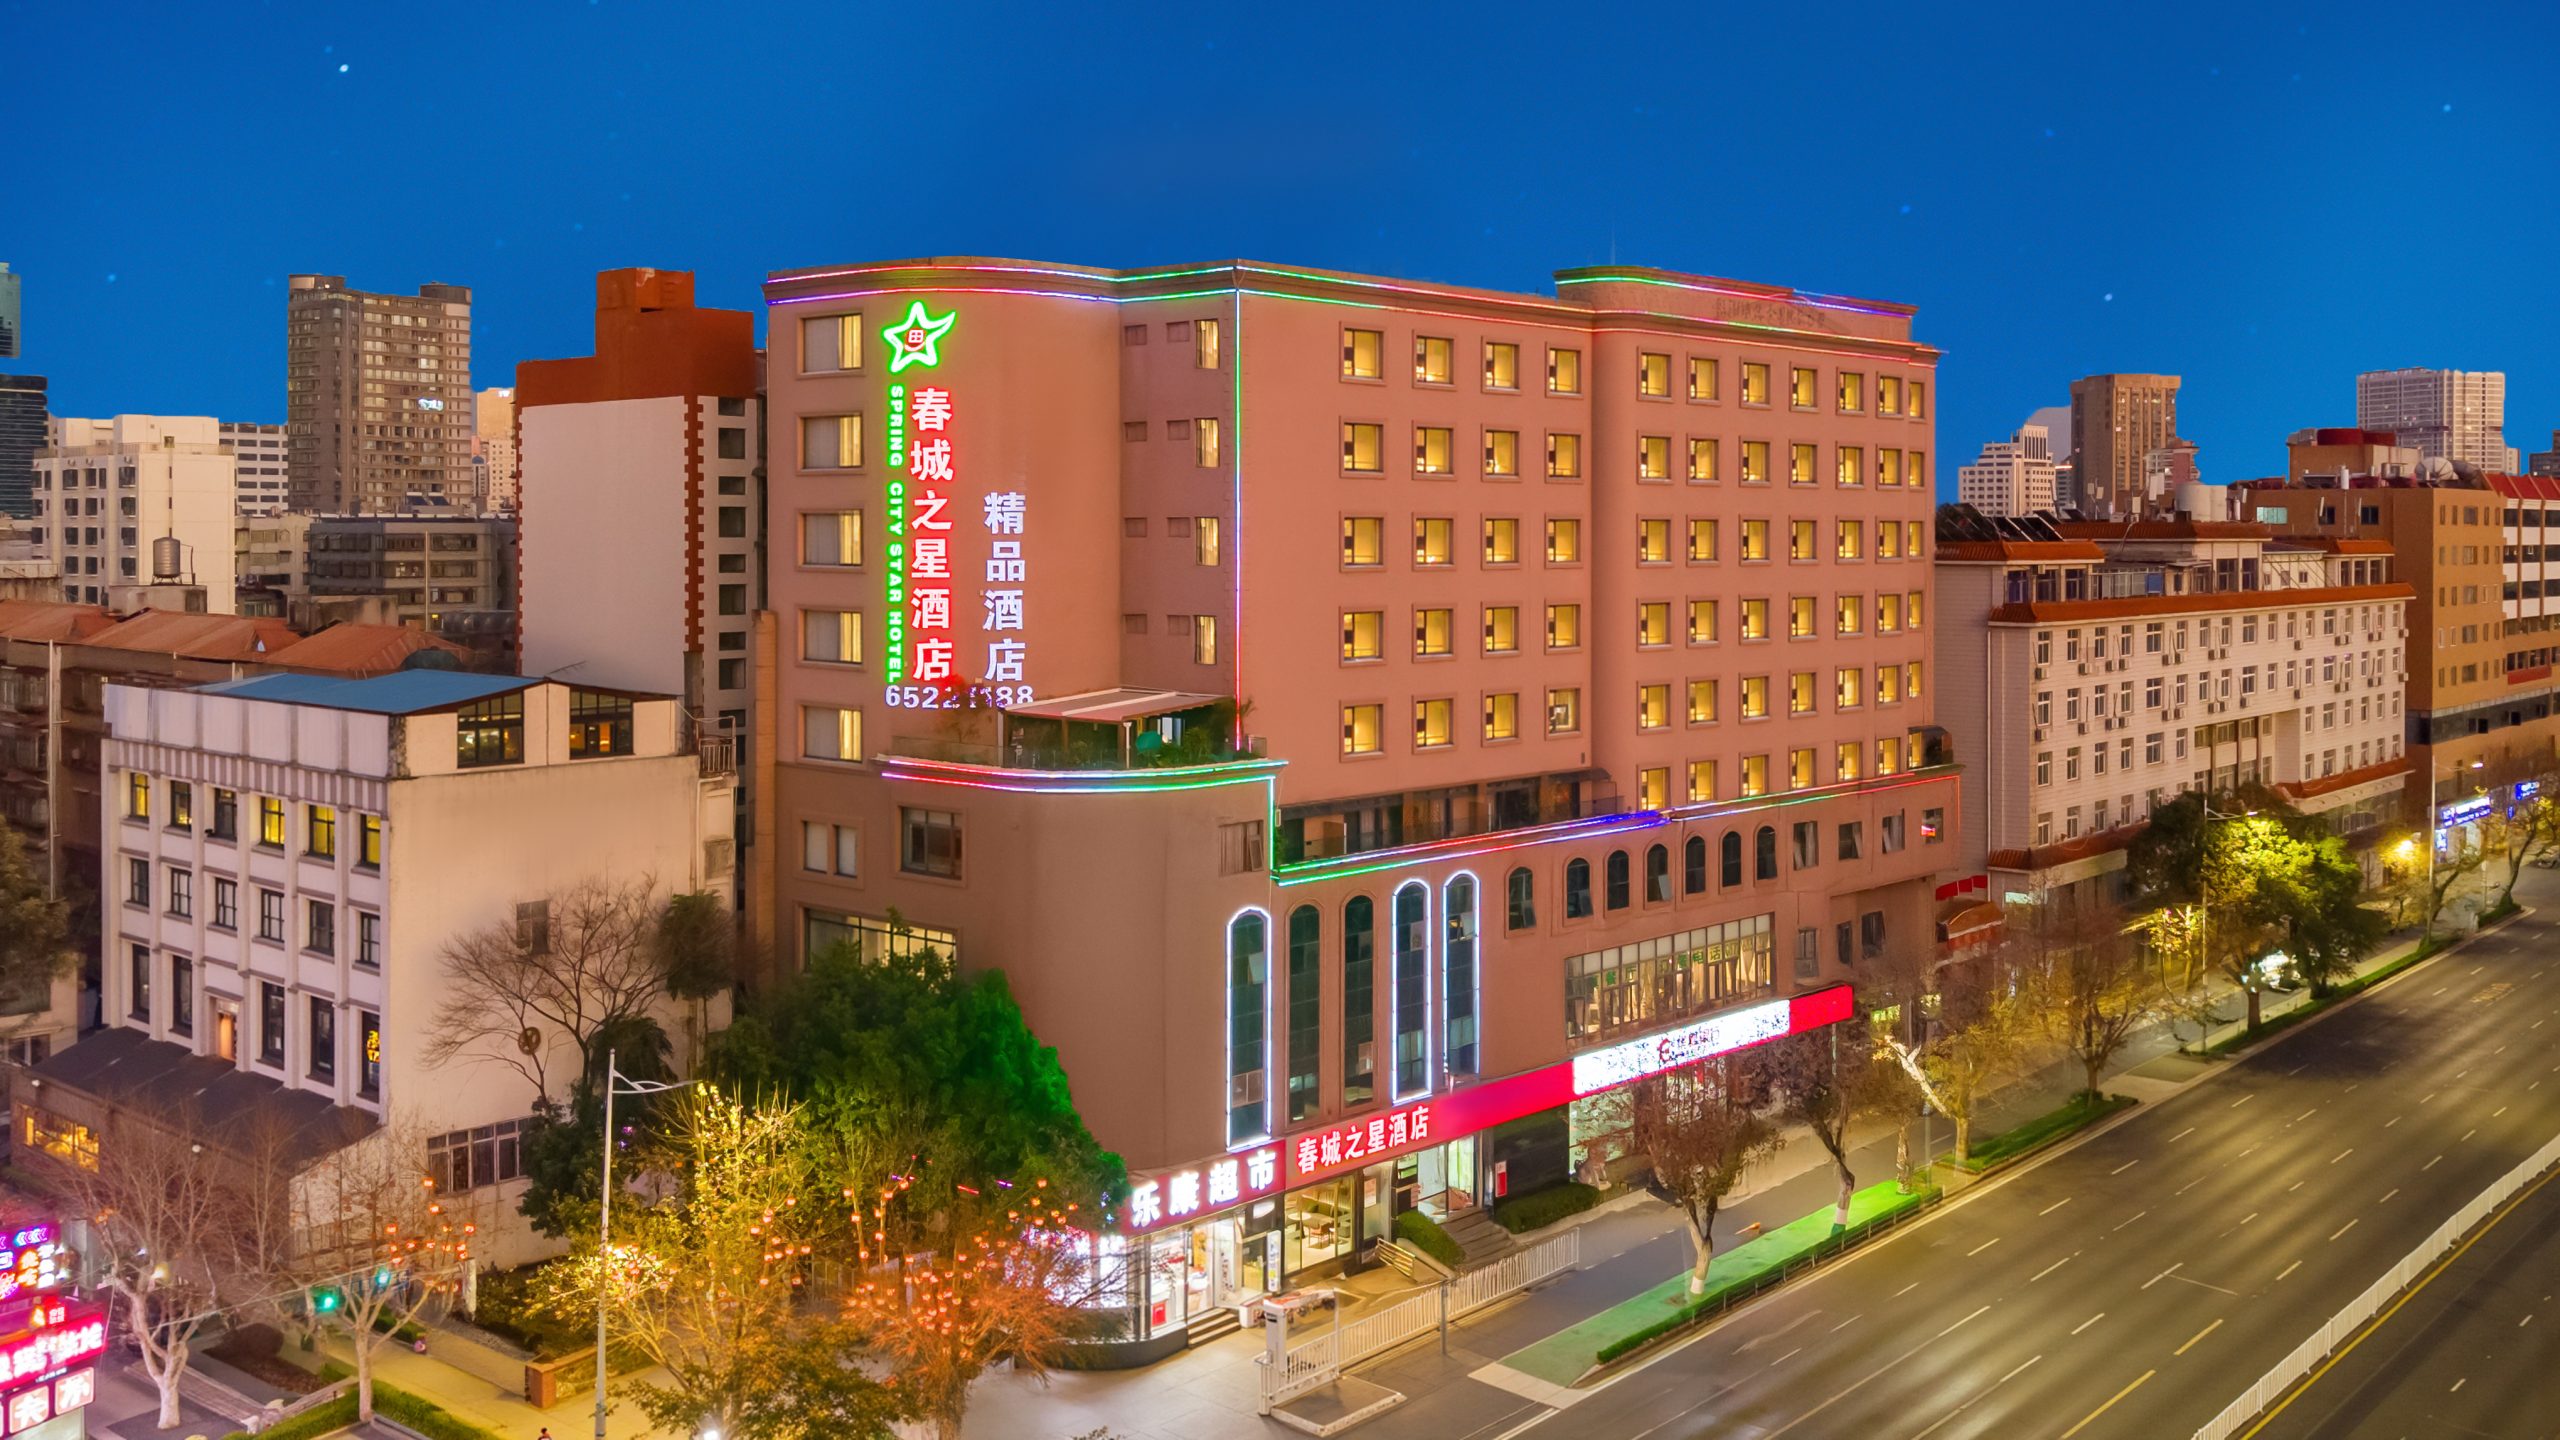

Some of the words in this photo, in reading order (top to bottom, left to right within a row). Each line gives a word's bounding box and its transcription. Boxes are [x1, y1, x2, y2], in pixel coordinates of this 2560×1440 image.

[891, 385, 904, 466] SPRING
[889, 482, 904, 535] CITY
[911, 388, 954, 681] 春城之星酒店
[889, 543, 903, 602] STAR
[983, 491, 1026, 682] 精品酒店
[889, 611, 903, 682] HOTEL
[1298, 1105, 1429, 1174] 春城之星酒店
[1132, 1150, 1276, 1227] 乐康超市
